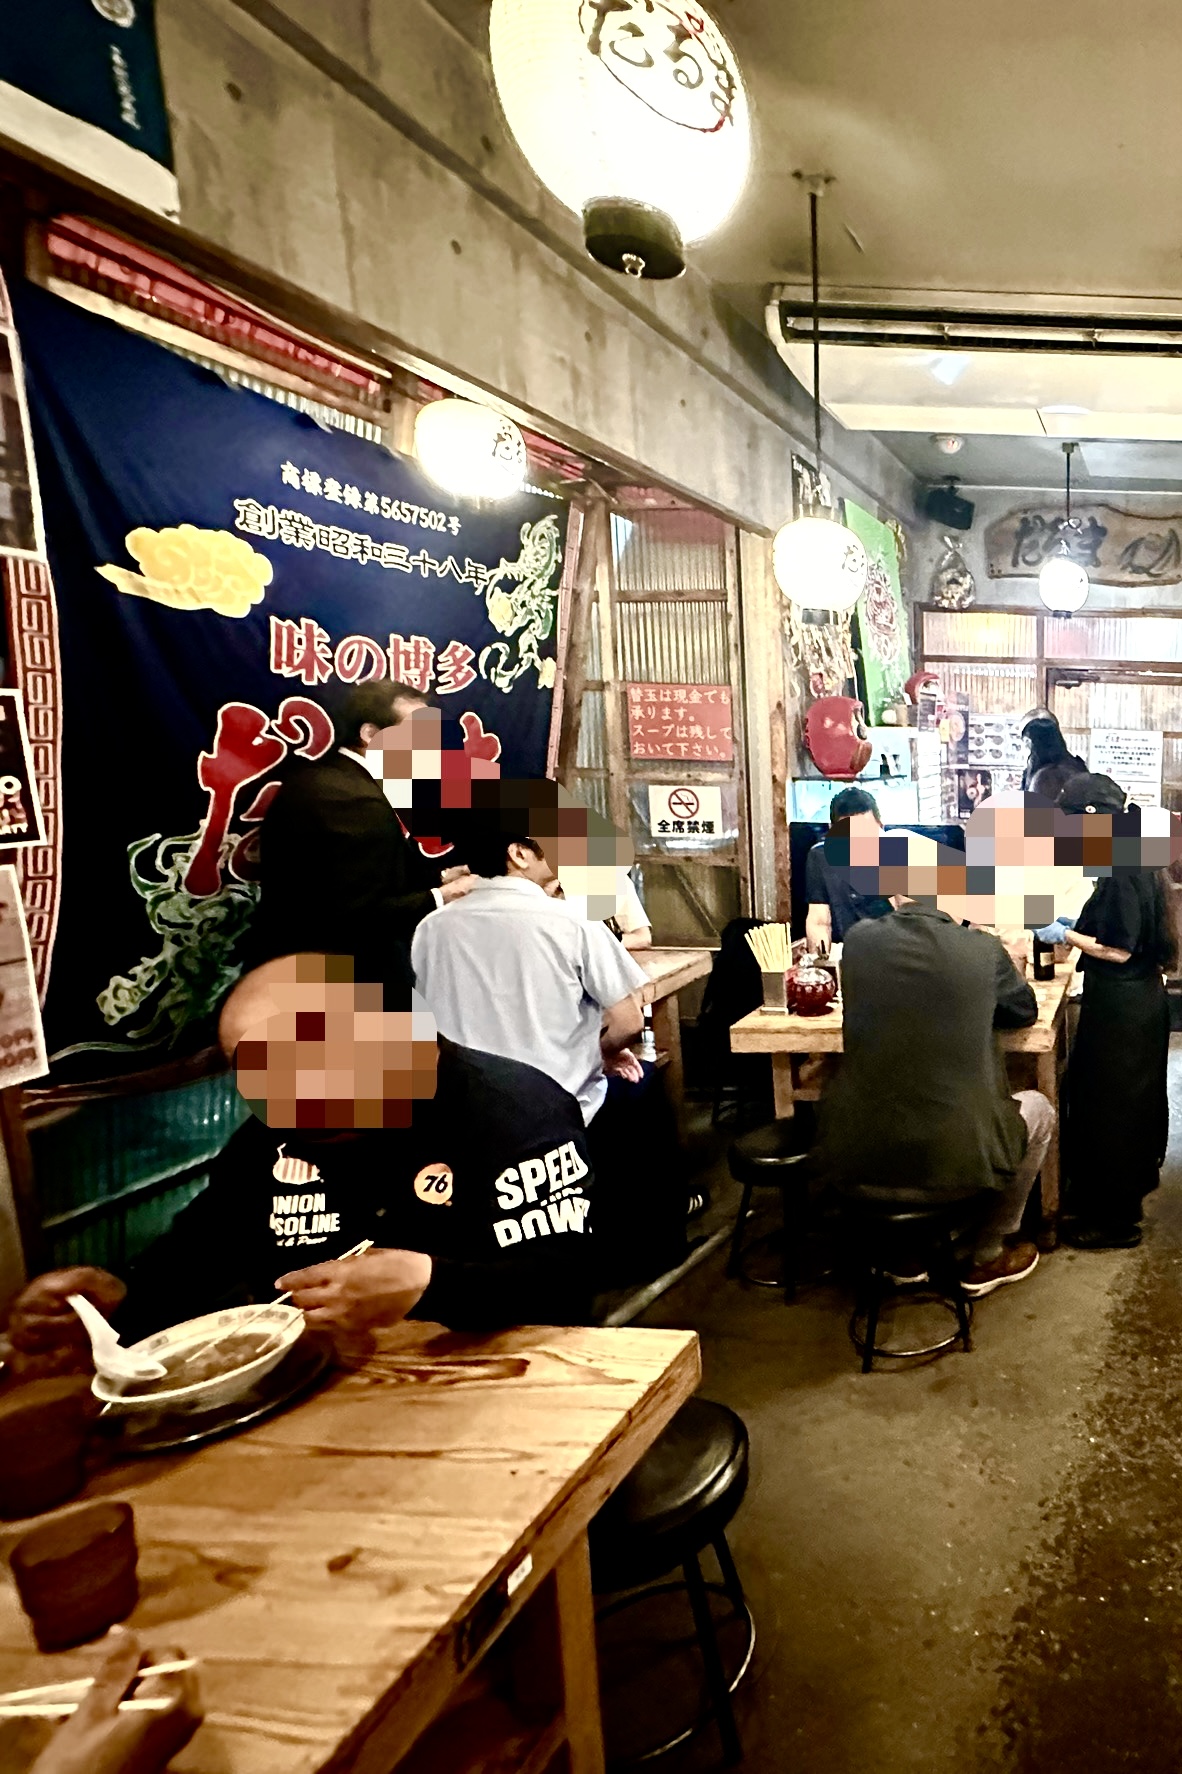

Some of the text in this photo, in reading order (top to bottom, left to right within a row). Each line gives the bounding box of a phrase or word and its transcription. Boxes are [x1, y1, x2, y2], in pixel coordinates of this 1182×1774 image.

[234, 499, 490, 595] 創業昭和三十八年
[269, 614, 478, 695] 味の博多
[631, 704, 695, 722] 承ります。
[632, 724, 732, 740] スープは残して
[632, 743, 726, 757] おいて下さい。
[657, 820, 715, 834] 全席禁煙
[424, 1174, 449, 1194] 76
[494, 1141, 589, 1210] SPEED
